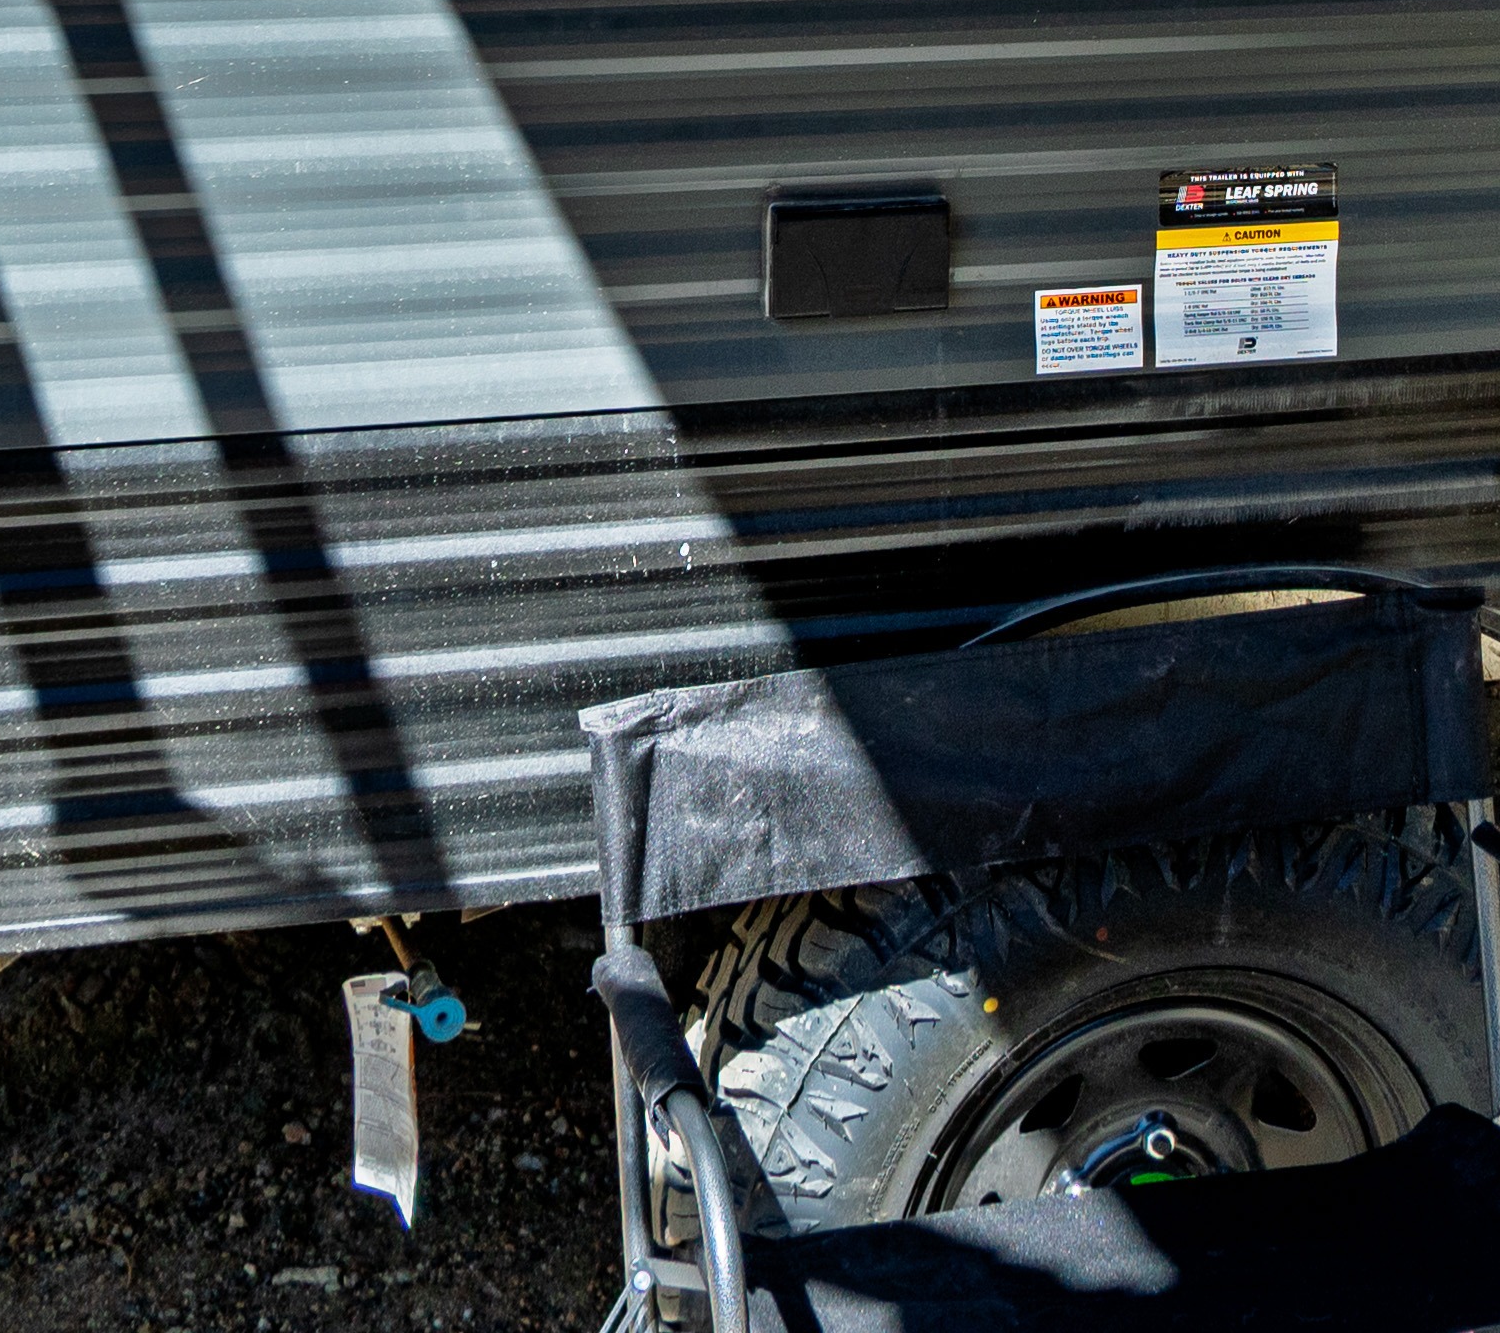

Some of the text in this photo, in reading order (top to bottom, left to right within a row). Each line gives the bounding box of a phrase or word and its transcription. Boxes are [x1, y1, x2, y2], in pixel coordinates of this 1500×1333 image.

[1209, 174, 1238, 182] TRAILER
[1250, 172, 1284, 180] EQUIPPED
[1225, 185, 1261, 199] LEAF
[1264, 182, 1319, 198] SPRING
[1176, 202, 1204, 211] DEXTER
[1235, 229, 1281, 240] CAUTION
[1209, 248, 1250, 257] SUSPENSION
[1059, 293, 1125, 306] WARNING
[1048, 323, 1074, 331] settings
